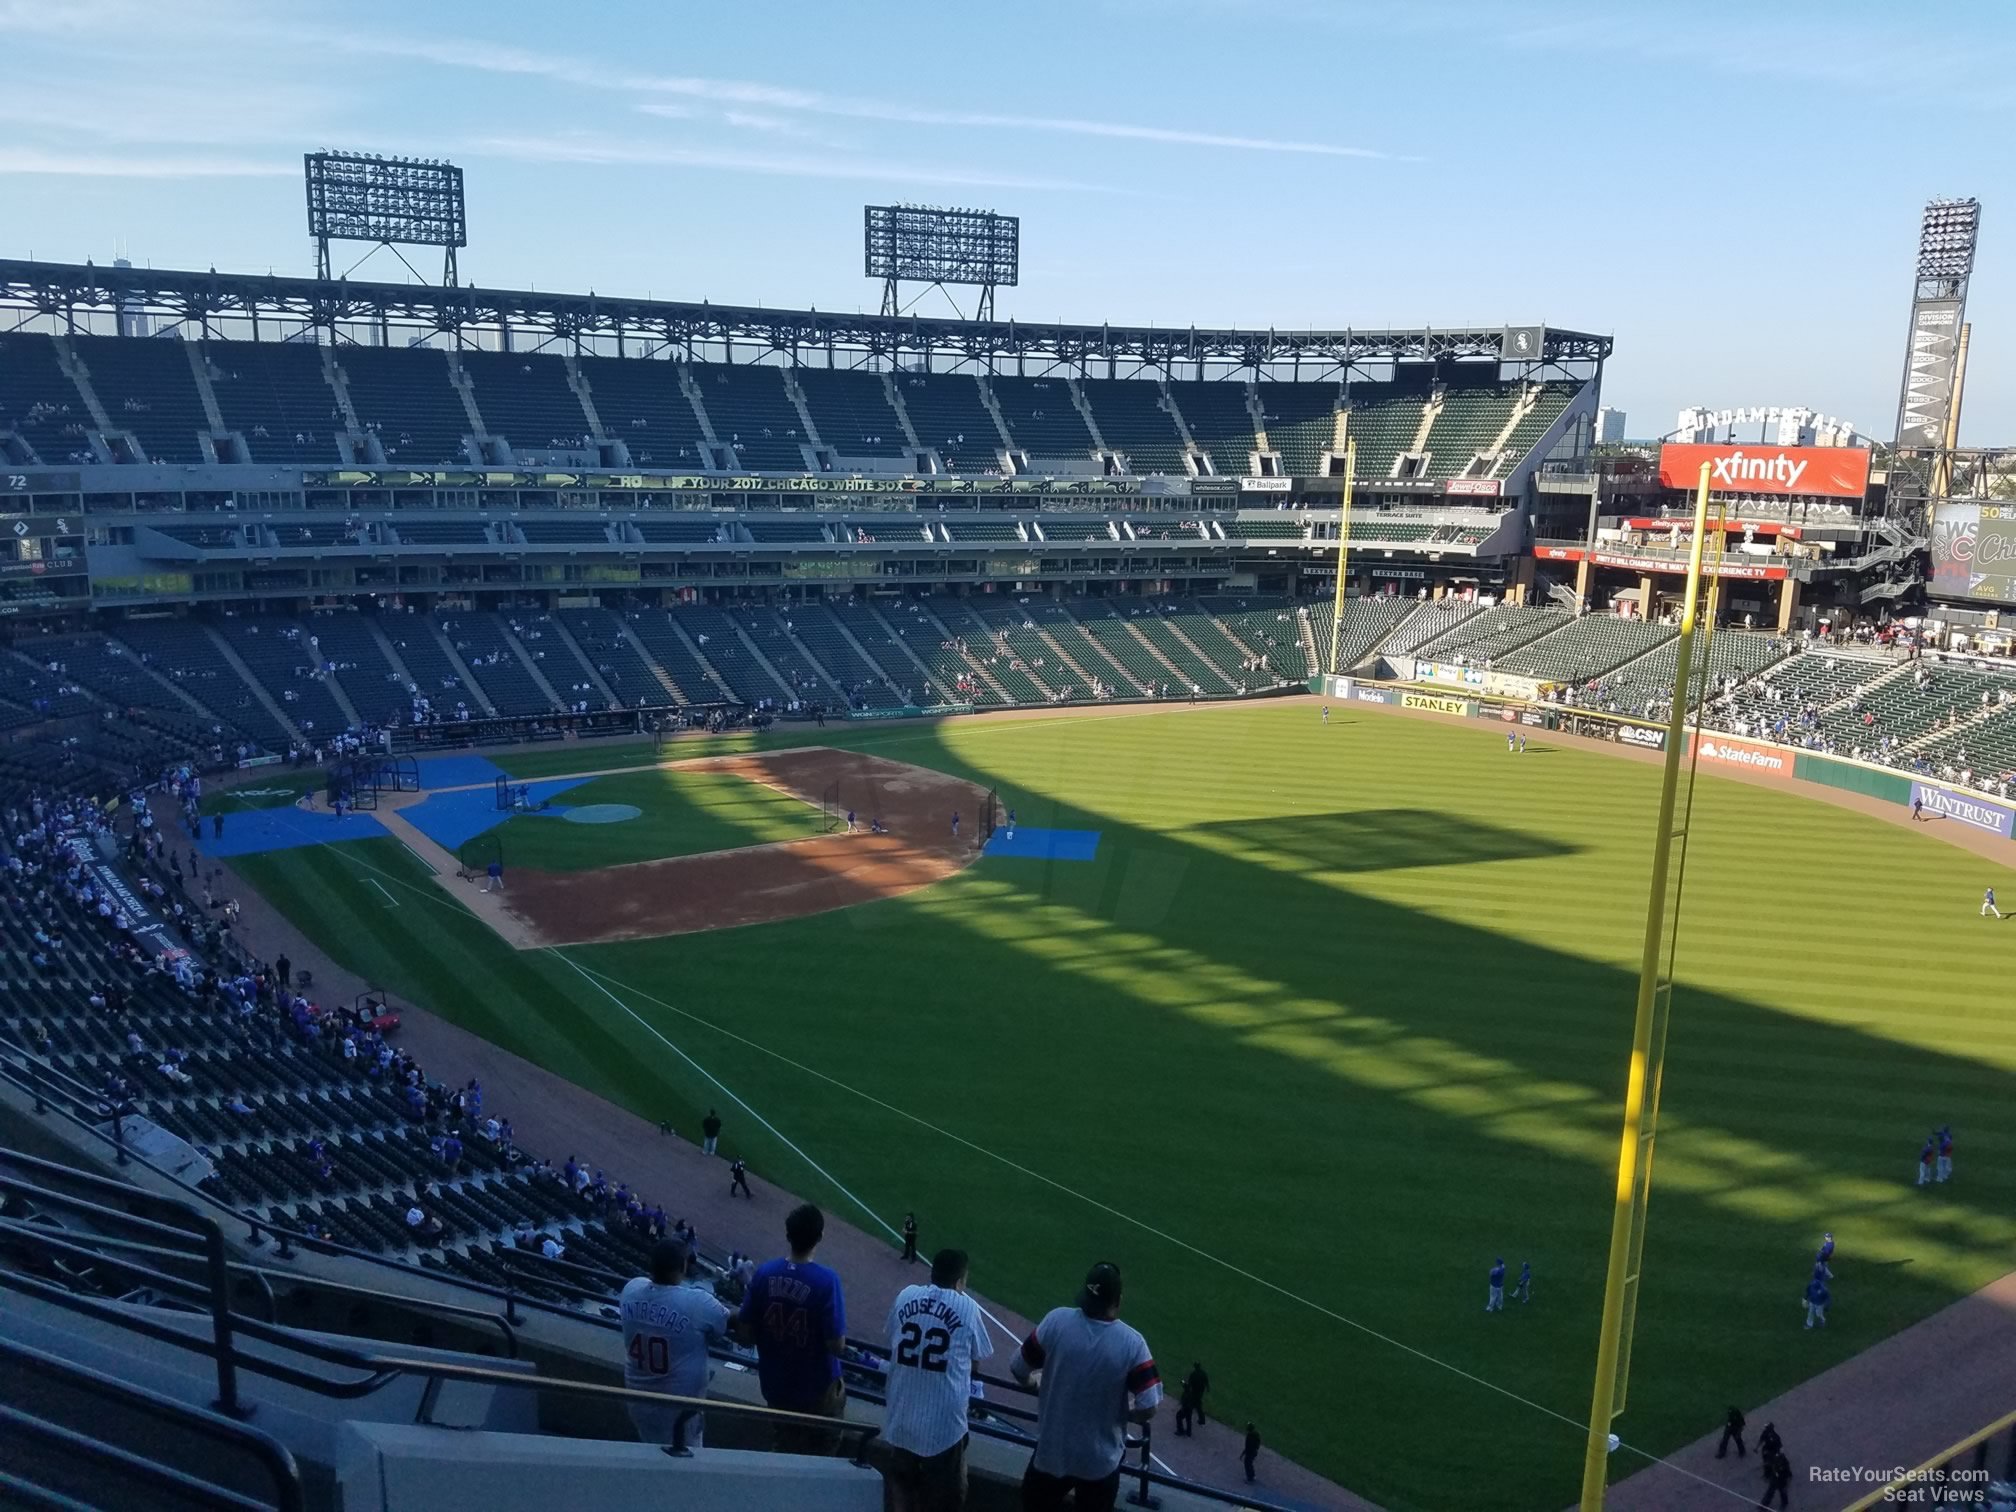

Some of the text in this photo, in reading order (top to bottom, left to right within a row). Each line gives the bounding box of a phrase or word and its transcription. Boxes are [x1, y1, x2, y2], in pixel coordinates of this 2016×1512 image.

[1711, 451, 1808, 488] xfinity
[8, 475, 27, 487] 72
[691, 477, 729, 489] YOUR
[732, 477, 762, 489] 2017
[768, 479, 828, 490] CHICAGO
[829, 480, 875, 491] WHITE
[879, 480, 904, 491] SOX
[1256, 481, 1287, 490] Ballpark
[1981, 507, 1999, 519] 50
[47, 560, 73, 568] CLUB
[1628, 559, 1654, 568] CHANGE
[1668, 563, 1685, 571] WAY
[1754, 568, 1766, 576] TV
[1358, 689, 1385, 704] Modelo
[1405, 696, 1463, 713] STANLEY
[1635, 728, 1664, 743] CSN
[1920, 786, 2006, 828] WINTRUST
[768, 1276, 811, 1305] RIZZO
[898, 1298, 963, 1335] PODSEDNIK
[763, 1302, 809, 1348] 44
[629, 1333, 670, 1375] 40
[897, 1321, 950, 1373] 22
